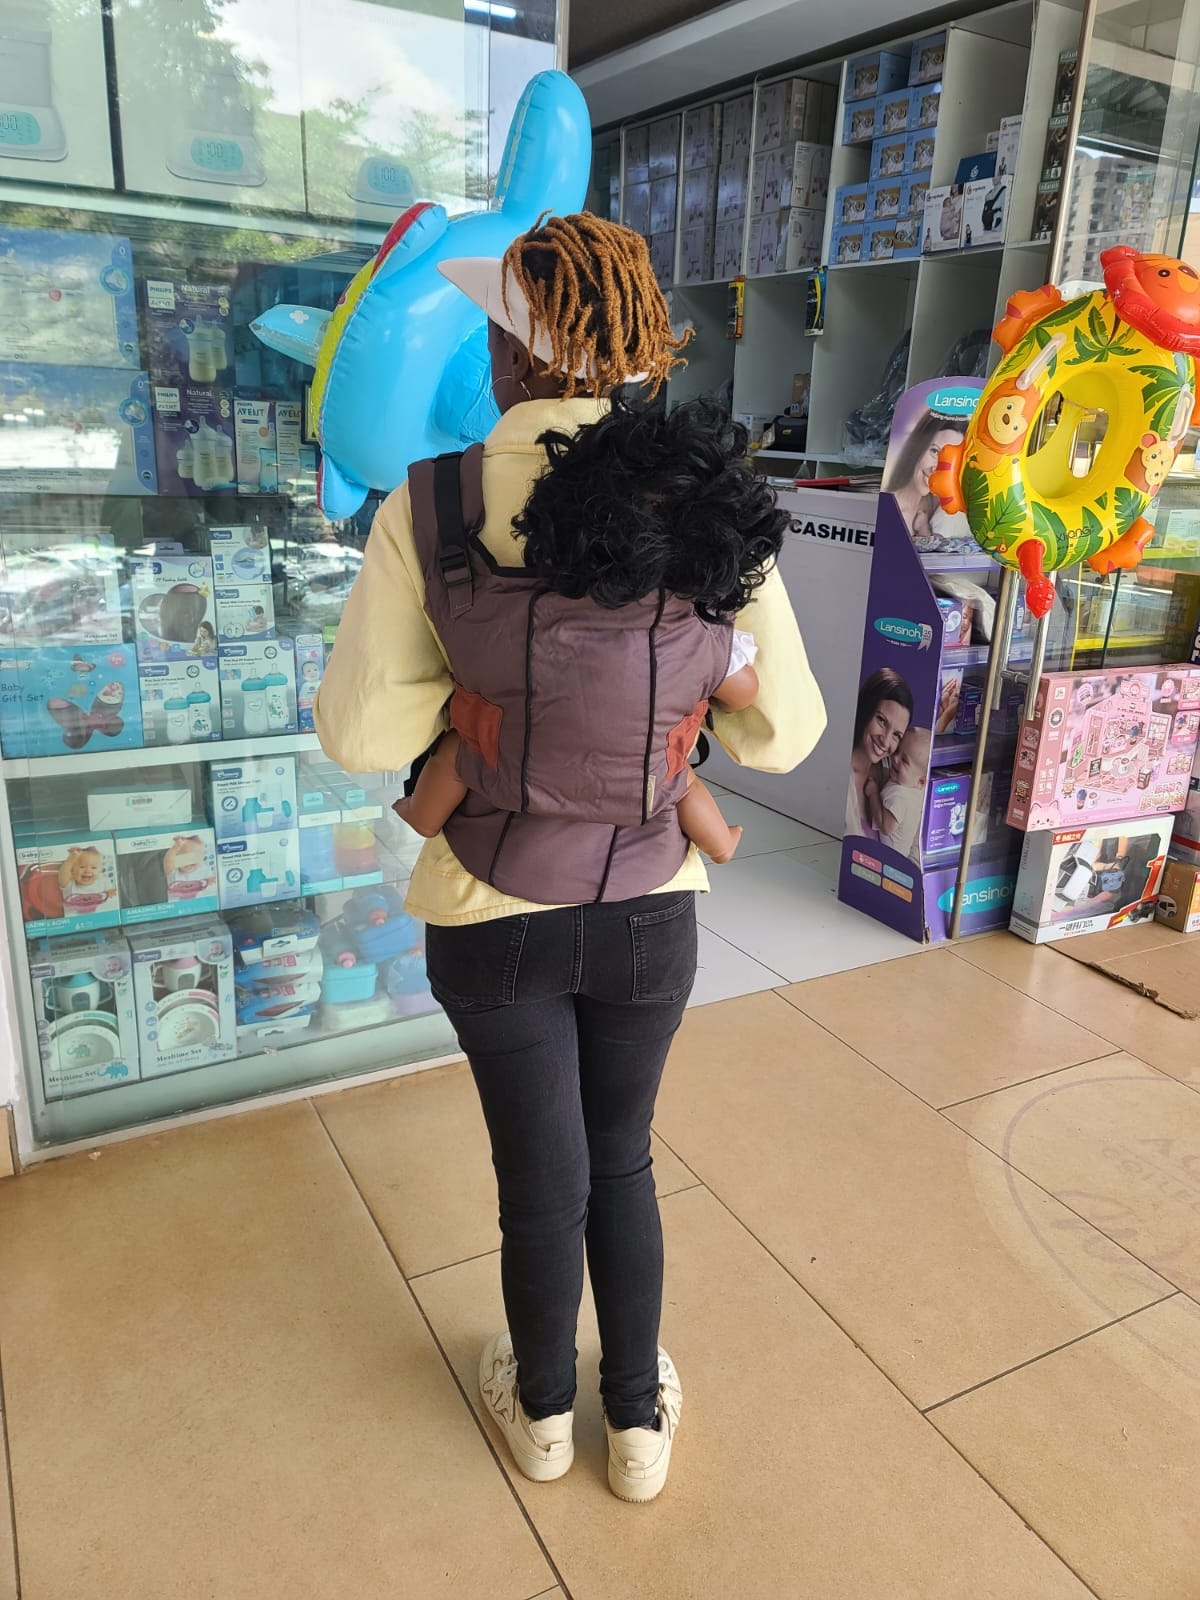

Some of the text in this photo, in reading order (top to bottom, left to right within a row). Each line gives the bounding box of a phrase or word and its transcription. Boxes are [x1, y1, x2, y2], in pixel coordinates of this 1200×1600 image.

[181, 284, 210, 294] Natural
[186, 388, 213, 397] Natural
[934, 393, 979, 408] Lansino
[880, 620, 922, 640] Lansinoh
[1, 683, 25, 694] Baby
[1, 694, 44, 703] Gift Set
[156, 1050, 189, 1063] Mealtime
[190, 1048, 202, 1056] Set
[49, 1071, 84, 1084] Mealtime
[84, 1070, 97, 1078] Set
